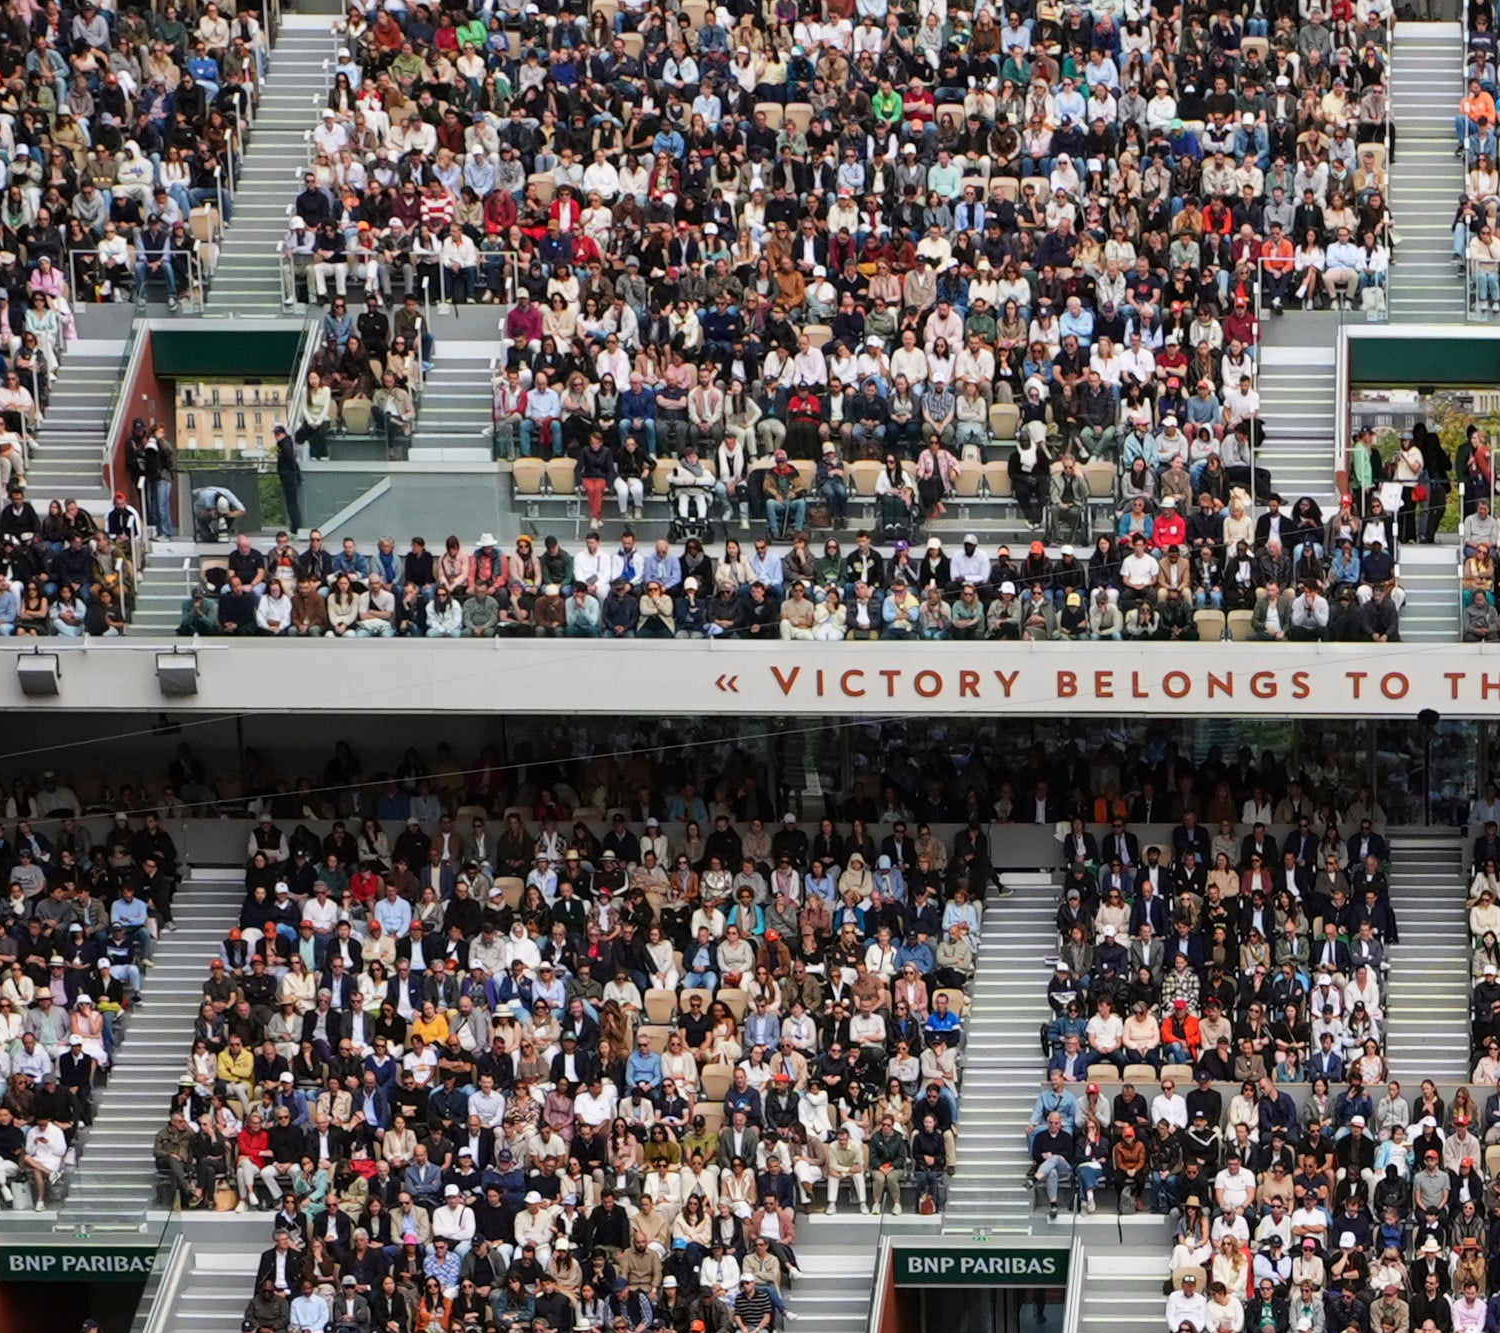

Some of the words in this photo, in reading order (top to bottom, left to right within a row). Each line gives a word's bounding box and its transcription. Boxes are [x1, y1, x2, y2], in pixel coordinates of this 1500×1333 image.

[771, 665, 1020, 698] VICTORY
[1057, 671, 1310, 699] BELONGS
[1345, 672, 1410, 699] TO
[9, 1255, 56, 1272] BNP
[62, 1255, 154, 1272] PARIBAS
[908, 1257, 954, 1273] BNP
[960, 1257, 1055, 1273] PARIBAS
